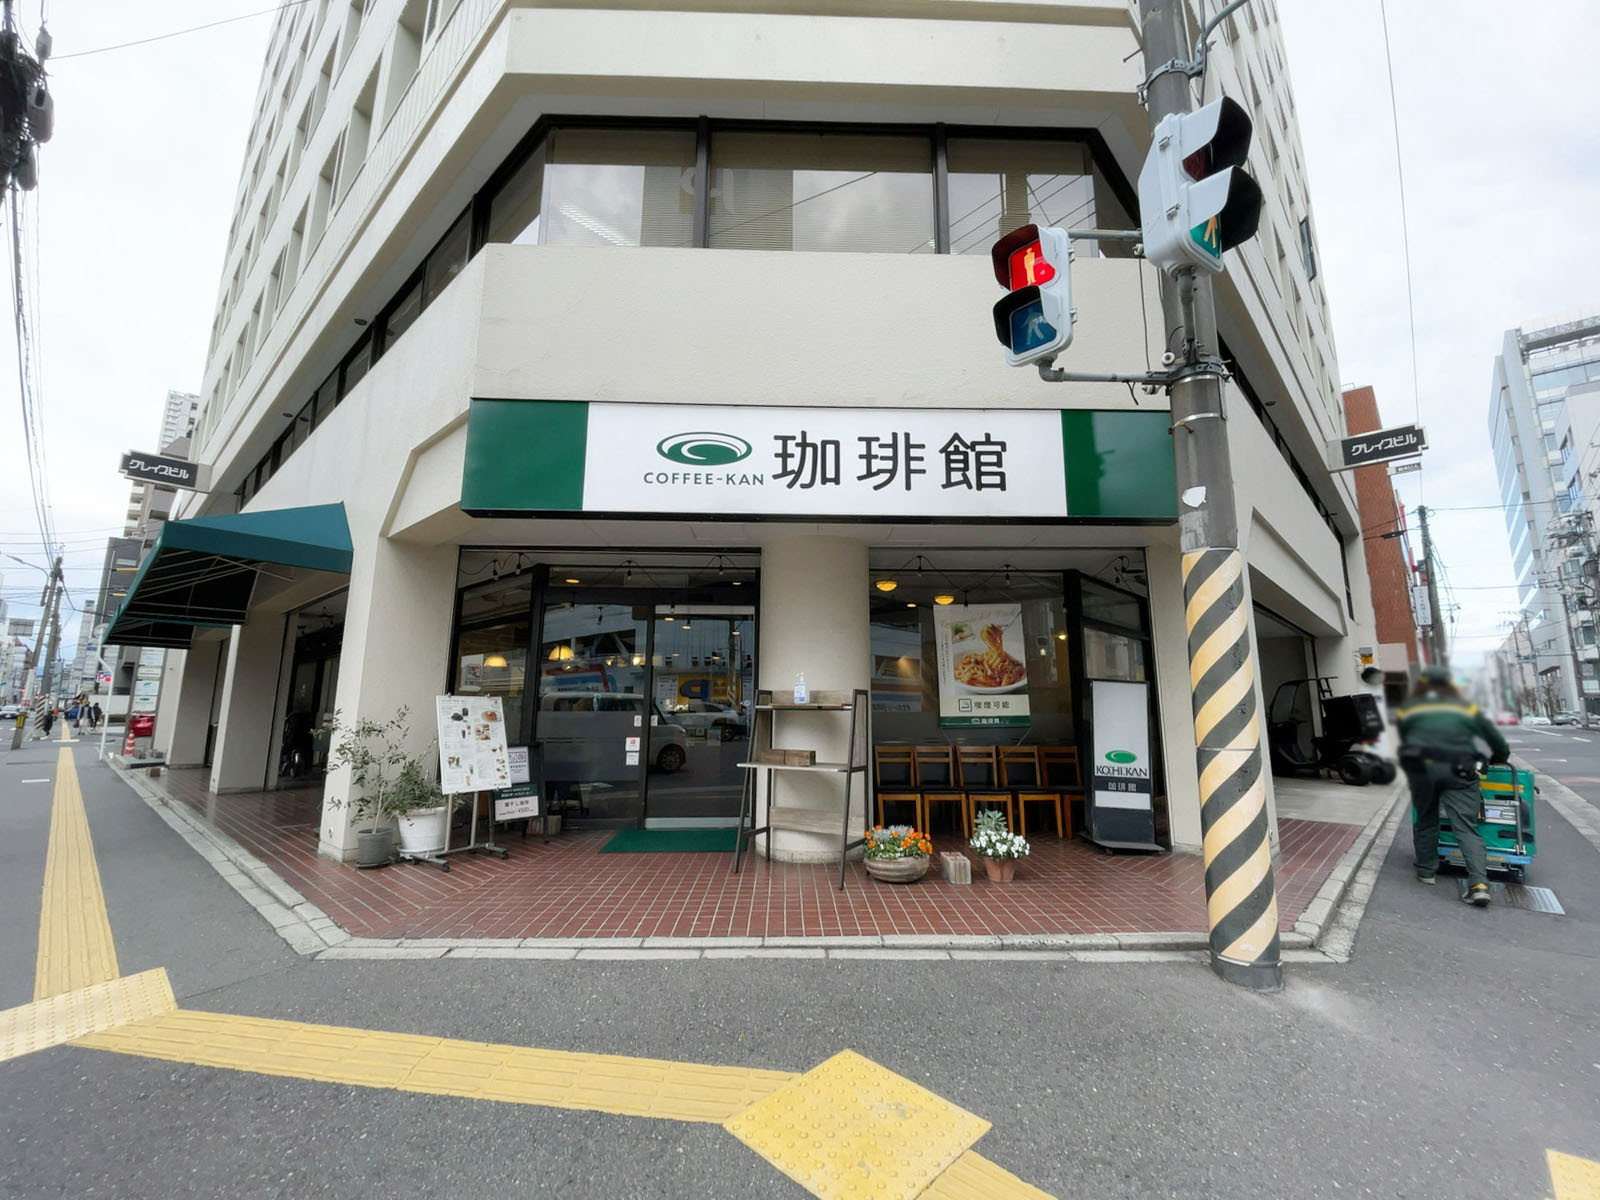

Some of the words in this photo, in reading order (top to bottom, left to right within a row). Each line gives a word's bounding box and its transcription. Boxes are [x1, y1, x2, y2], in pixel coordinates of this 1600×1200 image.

[1351, 433, 1417, 456] グレイスビル
[129, 459, 189, 479] グレイスビル
[772, 430, 1007, 492] 珈琲館
[643, 471, 764, 486] COFFEE-KAN
